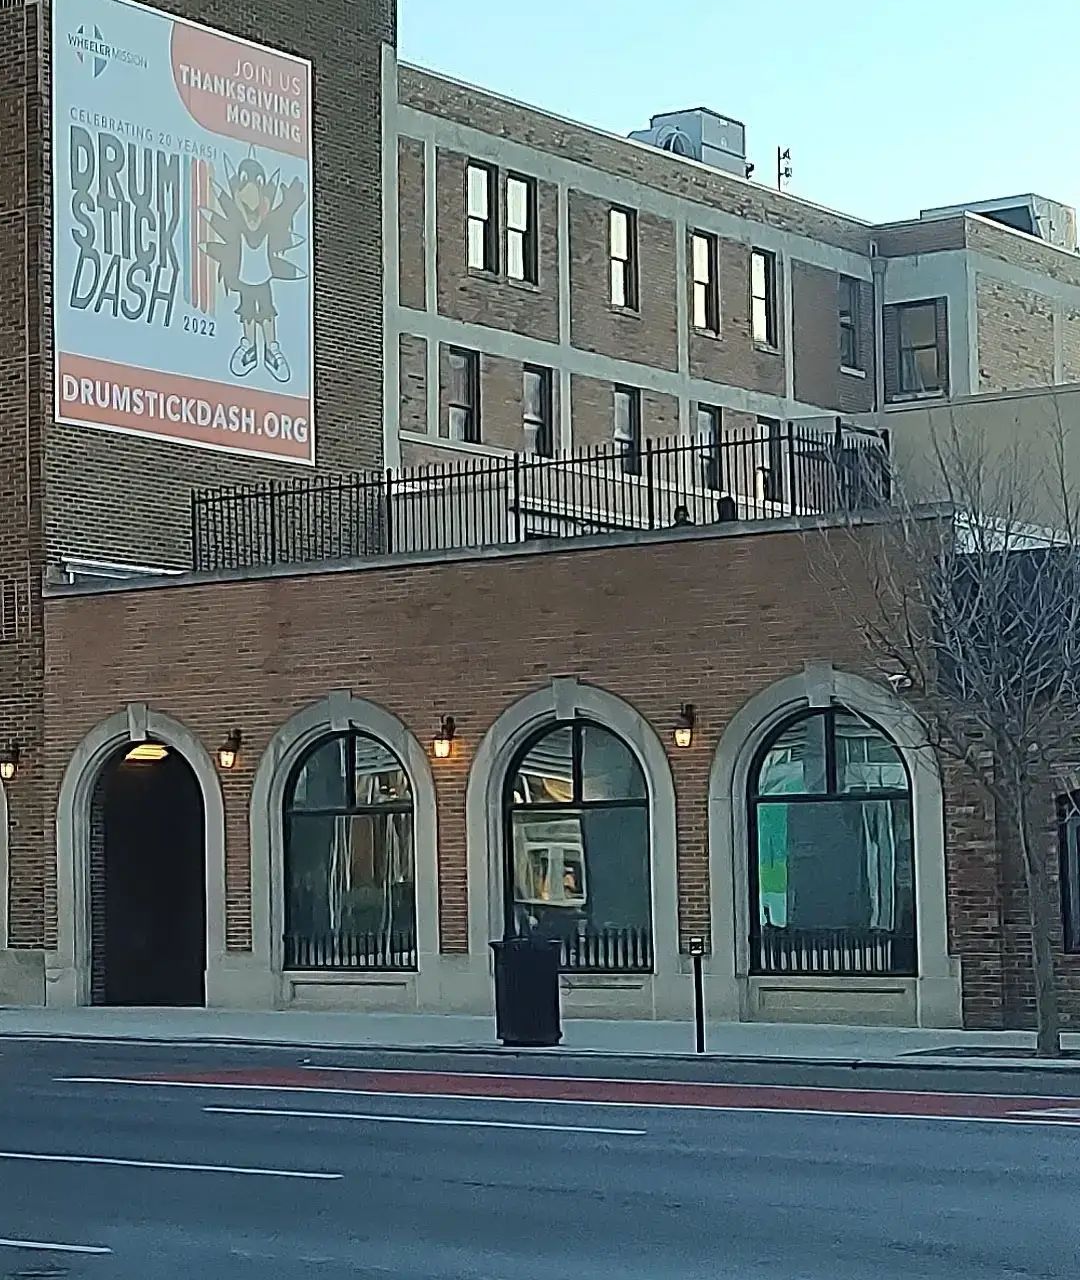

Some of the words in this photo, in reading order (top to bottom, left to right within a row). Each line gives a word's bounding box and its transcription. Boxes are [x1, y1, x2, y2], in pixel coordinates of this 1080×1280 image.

[67, 32, 111, 59] WHEELER
[111, 46, 148, 69] MISSION
[179, 63, 301, 120] THANKSGIVING
[233, 59, 273, 88] JOIN
[279, 70, 301, 96] US
[70, 106, 154, 142] CELEBRATING
[158, 131, 172, 148] 20
[226, 103, 301, 143] MORNING
[69, 124, 181, 213] DRUM
[70, 188, 181, 271] STICK
[69, 246, 181, 328] DASH
[183, 315, 217, 338] 2022
[61, 373, 309, 444] DRUMSTICKDASH.ORG
